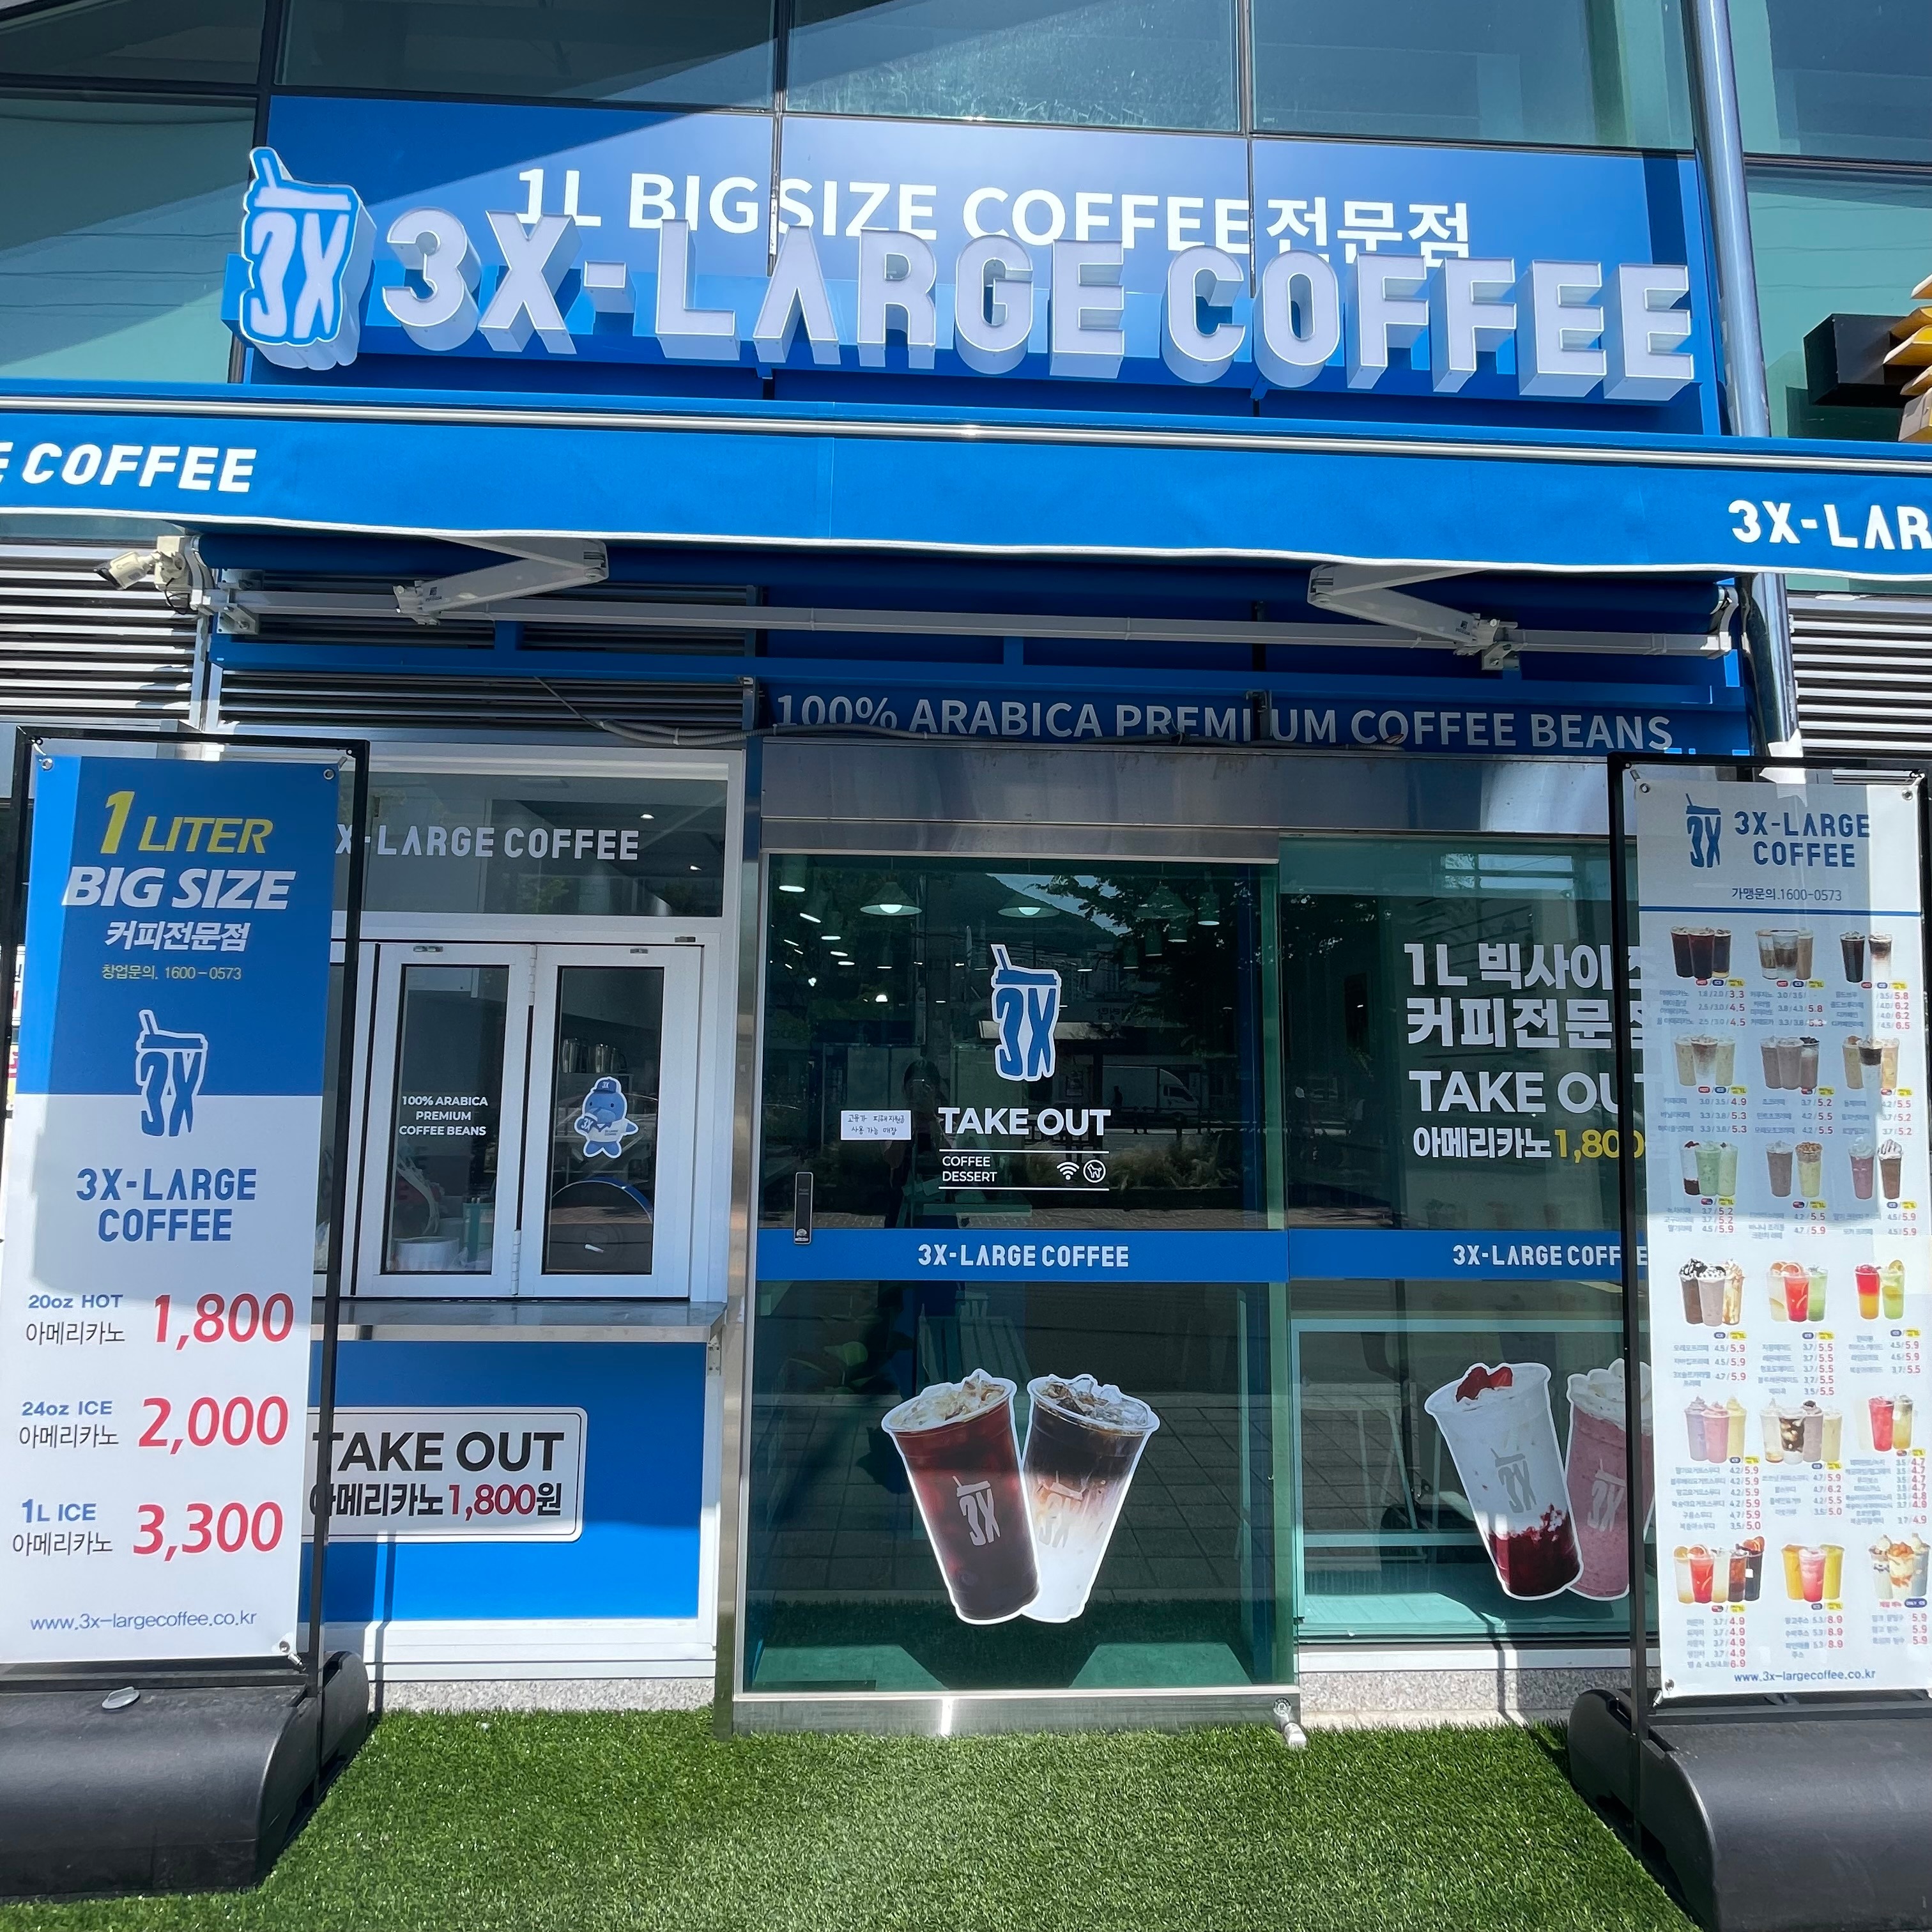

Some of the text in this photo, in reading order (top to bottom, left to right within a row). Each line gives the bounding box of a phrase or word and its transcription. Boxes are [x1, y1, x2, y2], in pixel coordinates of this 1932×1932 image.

[519, 169, 602, 227] 1L
[383, 207, 1695, 391] 3X-LARGE COFFEE
[22, 443, 257, 493] COFFEE
[778, 695, 1673, 750] 100% ARABICA PREMIUM COFFEE BEANS
[100, 792, 273, 854] 1 LITER
[1735, 811, 1869, 838] 3X-LARGE
[503, 827, 640, 860] COFFEE
[1754, 841, 1855, 868] COFFEE
[61, 867, 296, 910] BIG SIZE
[104, 921, 250, 953] 커피전문점
[165, 966, 241, 980] 1600-0573
[1404, 943, 1468, 986] 1L
[402, 1096, 488, 1107] 100% ARABICA
[1409, 1071, 1546, 1113] TAKE
[415, 1110, 471, 1121] PREMIUM
[939, 1107, 1111, 1136] TAKE OUT
[399, 1125, 486, 1136] COFFEE BEANS
[1413, 1127, 1552, 1158] 아메리카노
[942, 1156, 991, 1167] COFFEE
[76, 1169, 257, 1201] 3X-LARGE
[942, 1171, 997, 1183] DESSERT
[98, 1208, 233, 1242] COFFEE
[918, 1245, 1129, 1267] 3X-LARGE COFFEE
[1453, 1245, 1648, 1266] 3X-LARGE COFFE
[28, 1294, 123, 1308] 20oz HOT
[26, 1321, 125, 1346] 아메리카노
[153, 1292, 294, 1351] 1,800
[22, 1400, 112, 1416] 24oz ICE
[19, 1423, 119, 1449] 아메리카노
[138, 1396, 289, 1455] 2,000
[457, 1431, 564, 1472] OUT
[22, 1499, 96, 1523] 1L ICE
[12, 1531, 113, 1556] 아메리카노
[133, 1501, 283, 1562] 3,300
[30, 1610, 257, 1630] www.3x-largecoffee.co.kr
[1734, 1668, 1876, 1682] www.3x-largecoffee.co.kr
